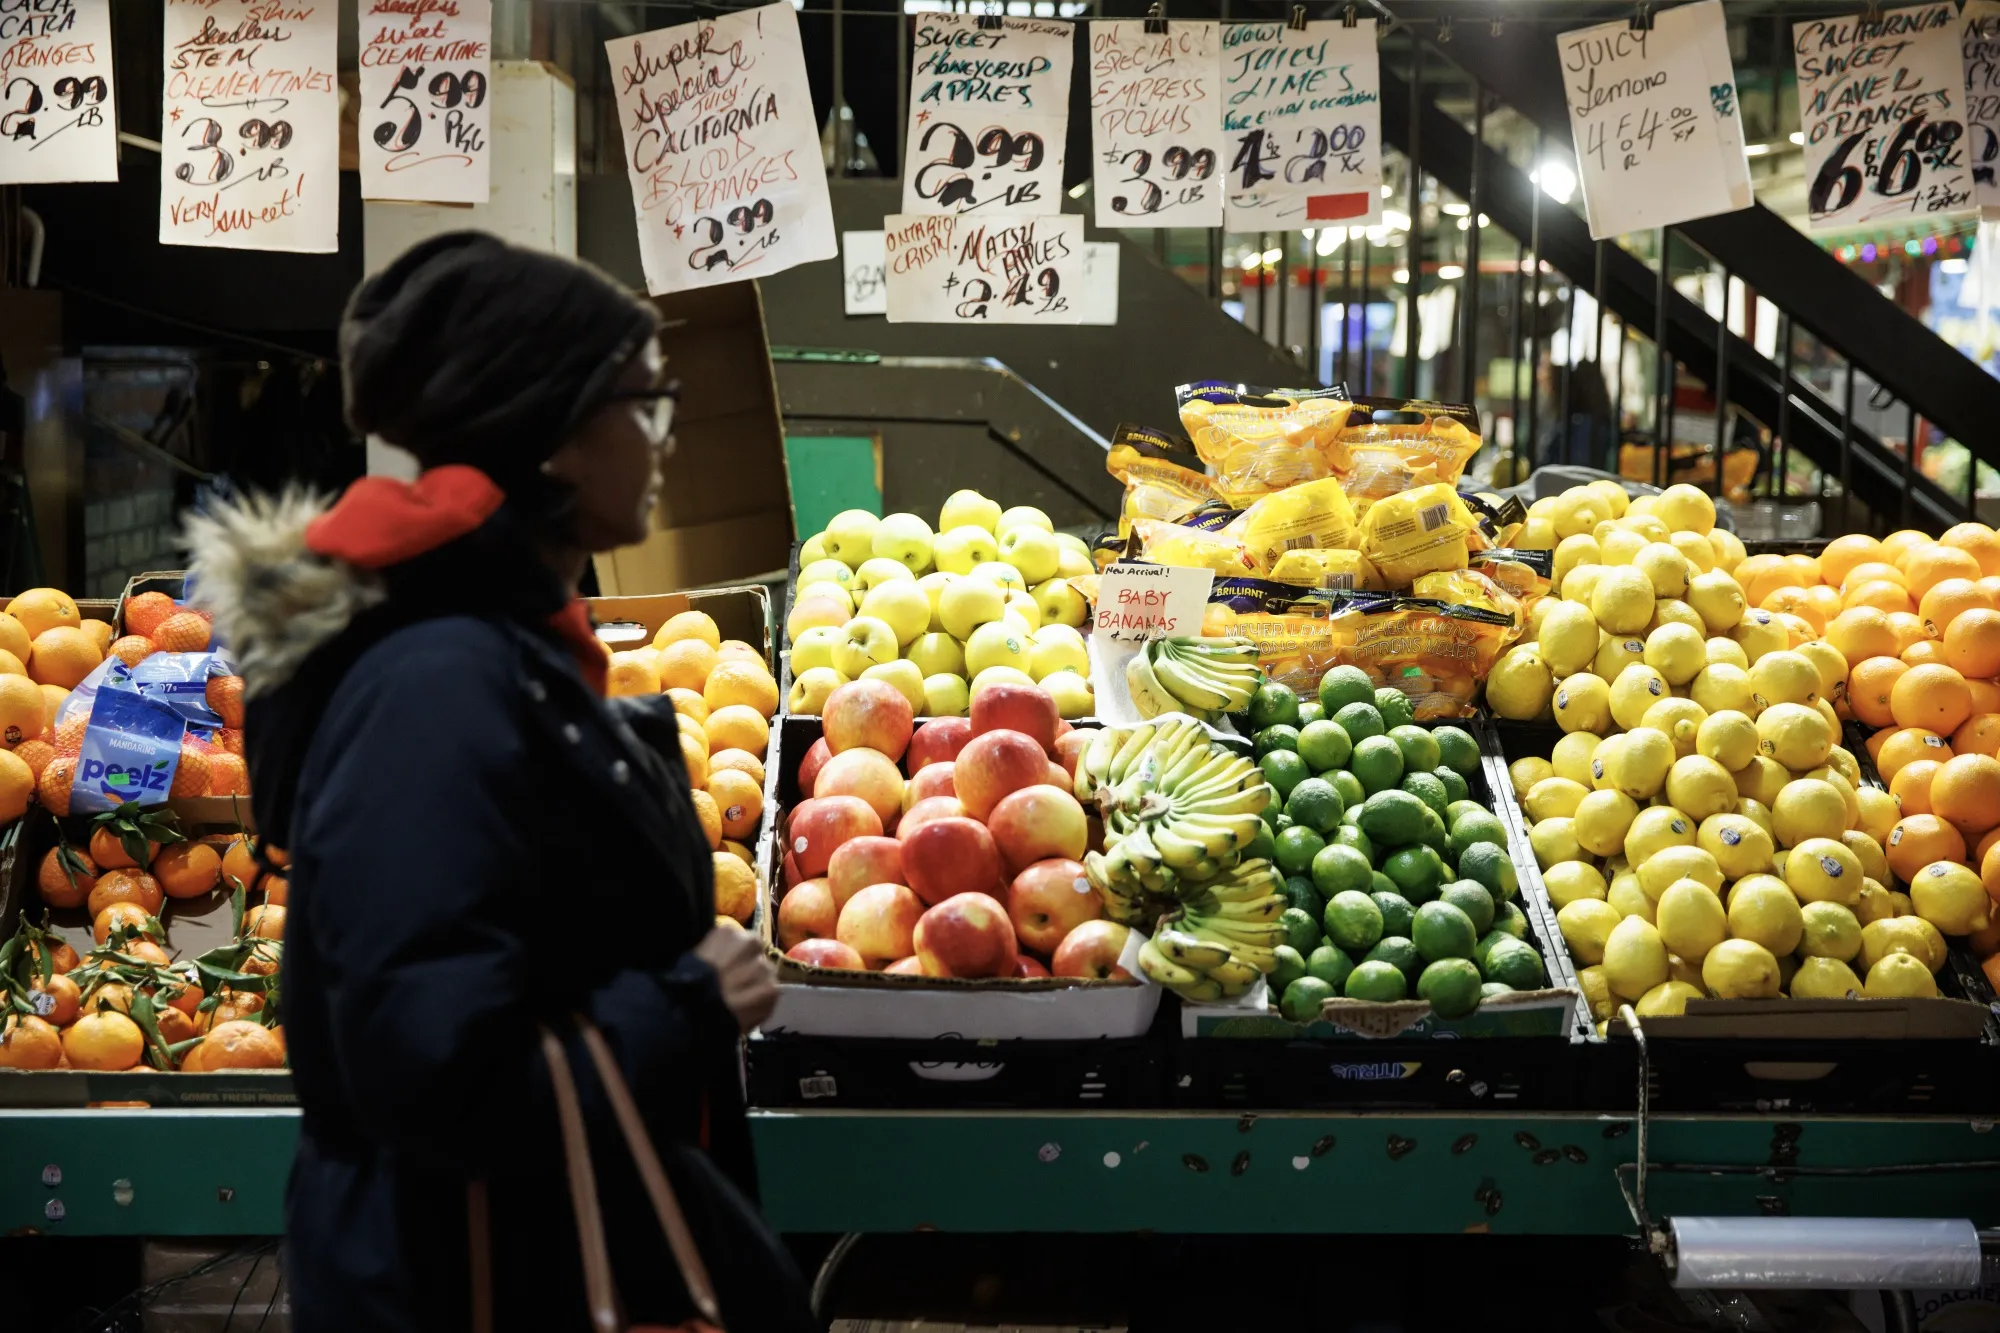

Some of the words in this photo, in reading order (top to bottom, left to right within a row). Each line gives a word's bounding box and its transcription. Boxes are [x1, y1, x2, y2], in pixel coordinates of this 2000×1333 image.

[0, 9, 76, 39] CARA
[915, 26, 1007, 50] SWEET
[1094, 24, 1119, 53] ON
[1796, 6, 1956, 54] CALIFORNIA
[1, 34, 95, 72] ORANGES
[360, 40, 487, 67] CLEMENTINE
[1566, 31, 1648, 72] JUICY
[1799, 40, 1914, 86] SWEET
[168, 67, 333, 99] CLEMENTINES
[919, 77, 1033, 108] APPLES
[1091, 78, 1206, 108] EMPRESS
[1805, 67, 1923, 116] NAVEL
[445, 109, 485, 153] PKG
[633, 85, 779, 174] CALIFORNIA
[1809, 88, 1952, 146] ORANGES
[1587, 121, 1608, 171] 4
[642, 135, 755, 210] BLOOD
[665, 150, 798, 226] ORANGES
[1809, 127, 1873, 220] 6
[1192, 386, 1237, 396] BRILLIANT
[1127, 432, 1169, 449] BRILLIANT
[1106, 567, 1124, 575] New
[1118, 589, 1172, 606] BABY
[1216, 587, 1264, 599] BRILLIANT
[1097, 611, 1177, 631] BANANAS
[1225, 622, 1284, 639] MEYER
[1354, 619, 1407, 645] MEYER
[1412, 619, 1477, 643] LEMONS
[1355, 637, 1421, 660] CITRONS
[1424, 639, 1477, 660] MEYER
[109, 738, 156, 756] MANDARINS
[81, 758, 169, 791] peelz
[1915, 1287, 2000, 1323] COACHE
